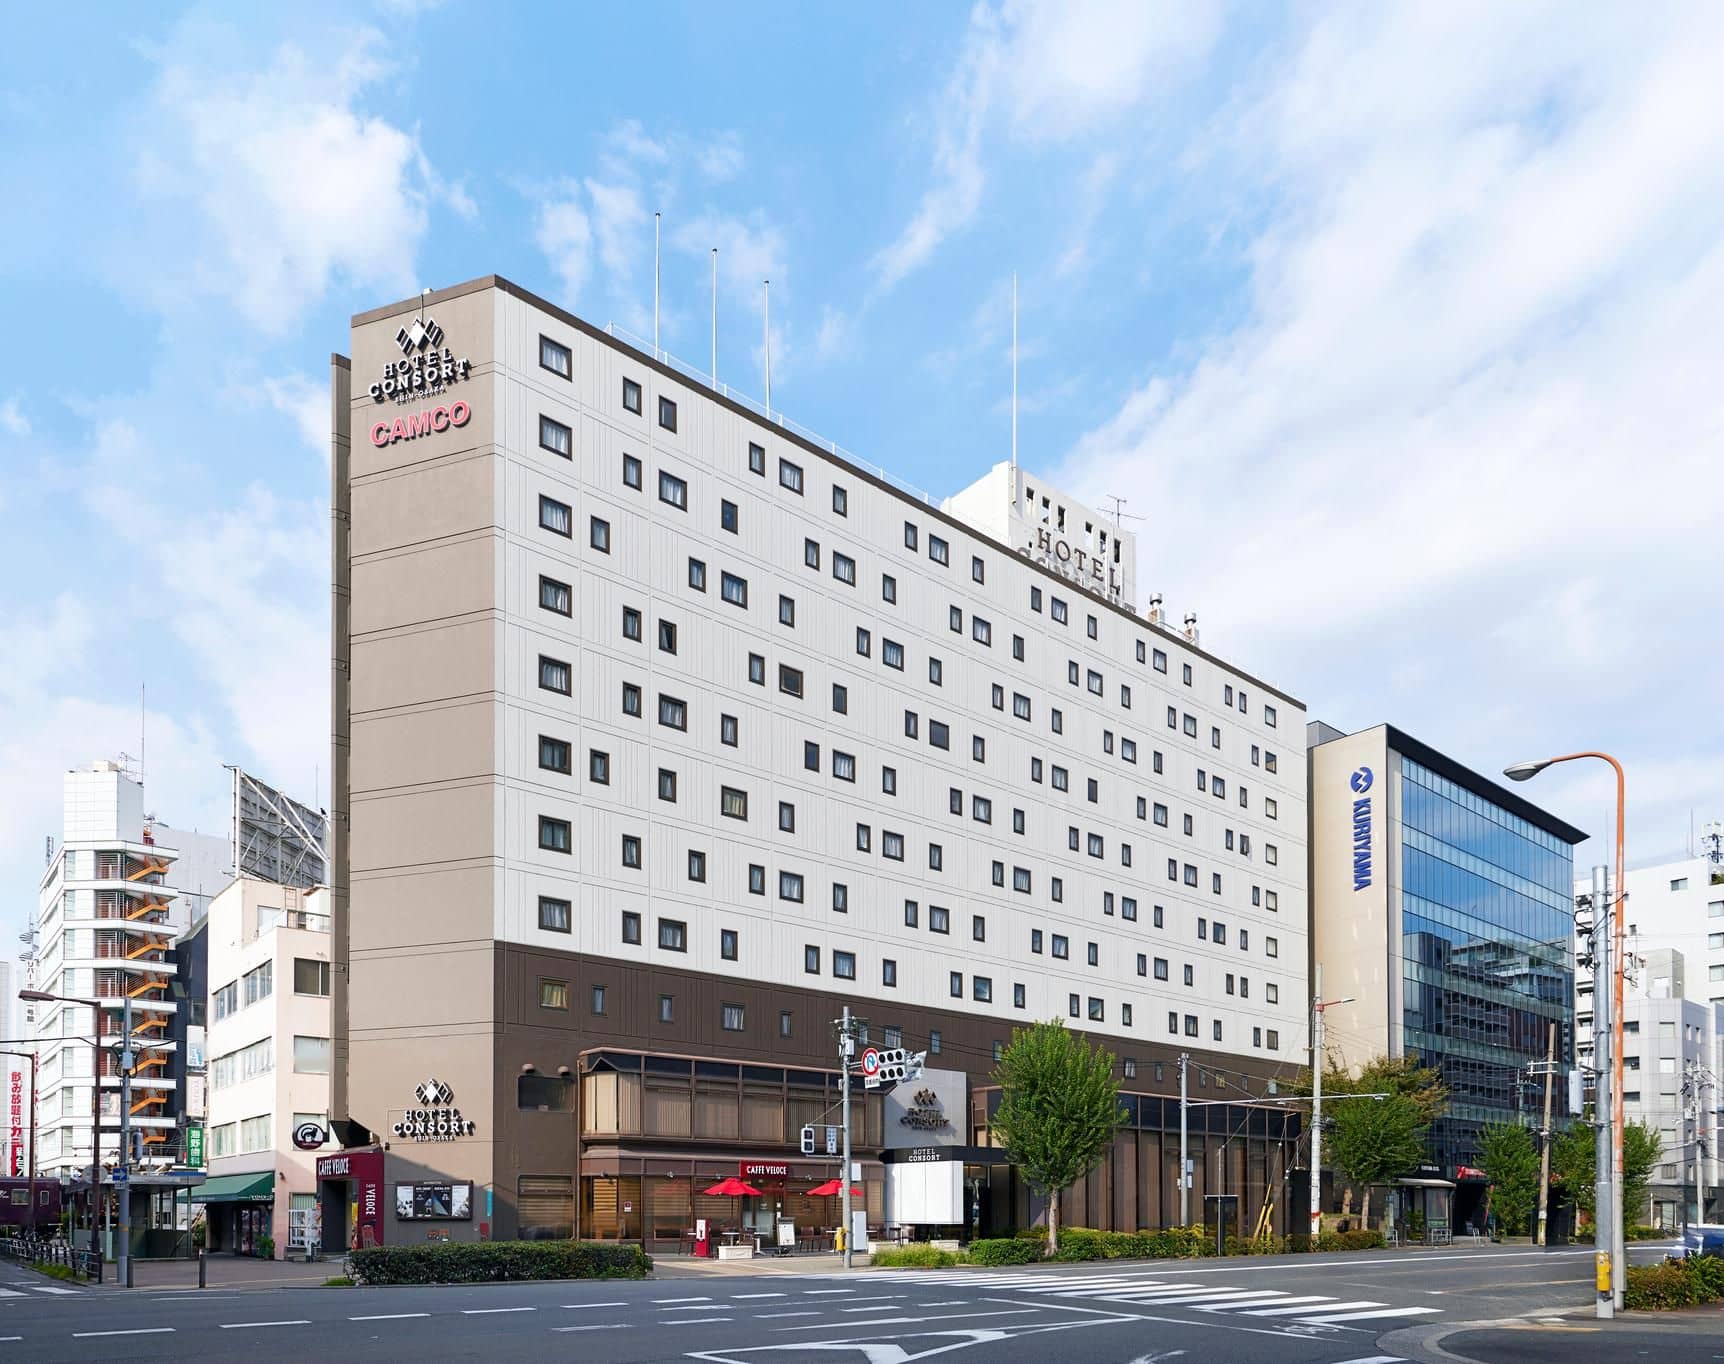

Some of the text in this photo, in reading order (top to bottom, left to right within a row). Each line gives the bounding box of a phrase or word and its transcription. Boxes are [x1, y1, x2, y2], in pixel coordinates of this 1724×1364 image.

[384, 348, 452, 376] HOTEL
[368, 358, 467, 397] CONSORT
[370, 400, 470, 446] CAMCO
[1037, 528, 1121, 596] HOTEL
[1353, 797, 1371, 892] KURIYAMA
[393, 1120, 471, 1134] CONSORT
[405, 1108, 459, 1121] HOTEL
[332, 1157, 349, 1175] VELOCE
[765, 1165, 787, 1175] VELOCE
[909, 1154, 940, 1162] CONSORT
[365, 1189, 376, 1215] VELOCE
